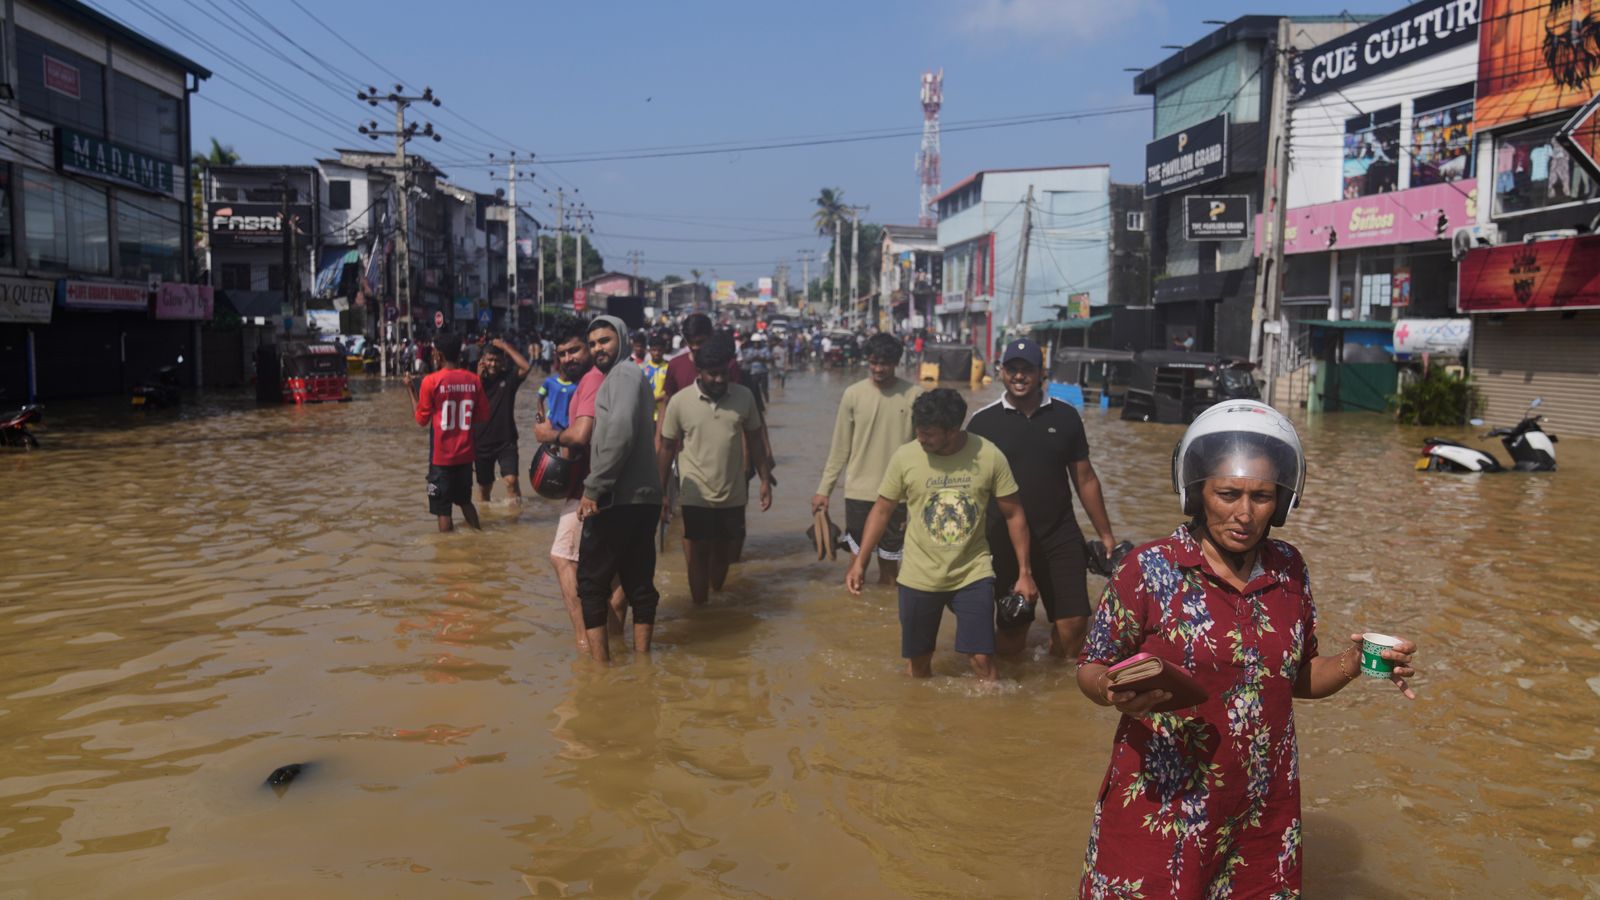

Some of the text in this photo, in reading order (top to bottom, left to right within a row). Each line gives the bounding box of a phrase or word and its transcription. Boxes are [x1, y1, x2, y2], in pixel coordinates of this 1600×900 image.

[1311, 42, 1357, 85] CUE
[73, 134, 167, 191] MADAME
[1148, 143, 1222, 183] THE PAVILION GRAND
[12, 284, 52, 306] QUEEN
[440, 399, 475, 431] 06
[925, 475, 972, 489] California
